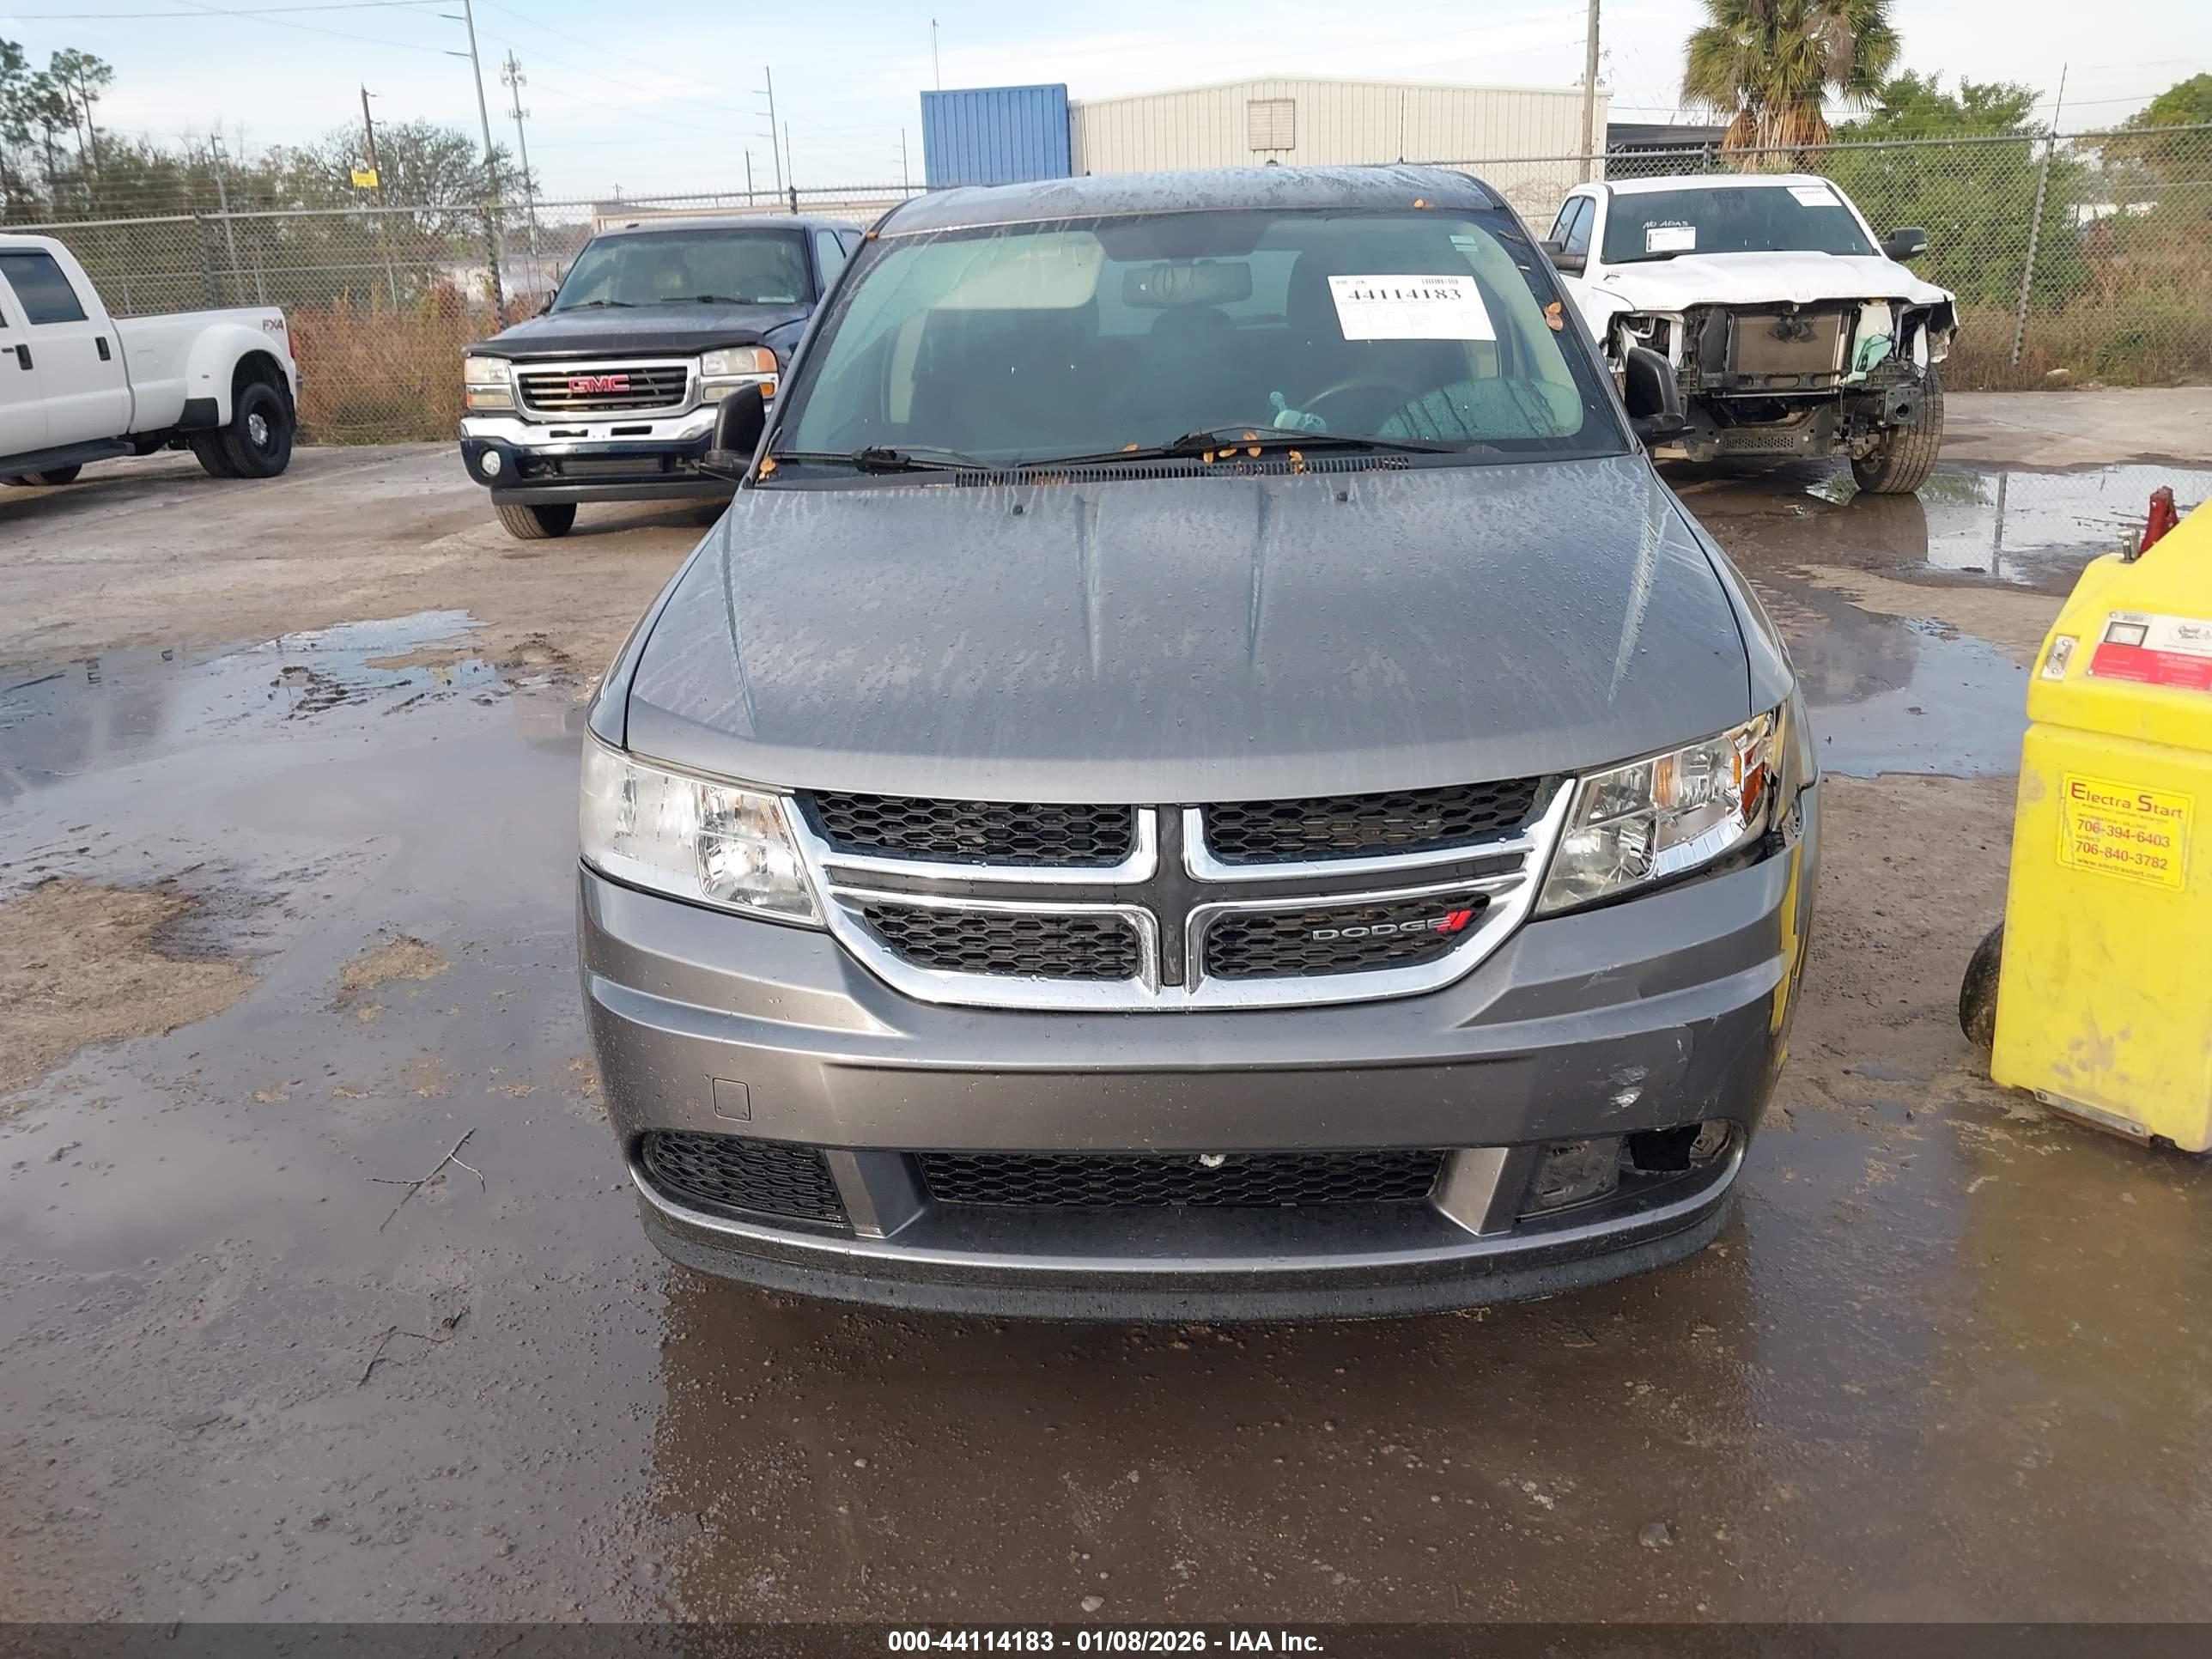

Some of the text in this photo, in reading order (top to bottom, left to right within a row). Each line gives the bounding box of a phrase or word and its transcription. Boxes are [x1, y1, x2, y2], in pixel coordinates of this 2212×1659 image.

[1347, 288, 1462, 301] 44114183
[568, 374, 631, 393] GMC
[2070, 781, 2132, 810] Electra
[2136, 793, 2185, 819] Start
[2076, 818, 2172, 848] 706-394-6403
[2075, 840, 2169, 871] 706-840-3782
[1312, 915, 1451, 941] DODGE
